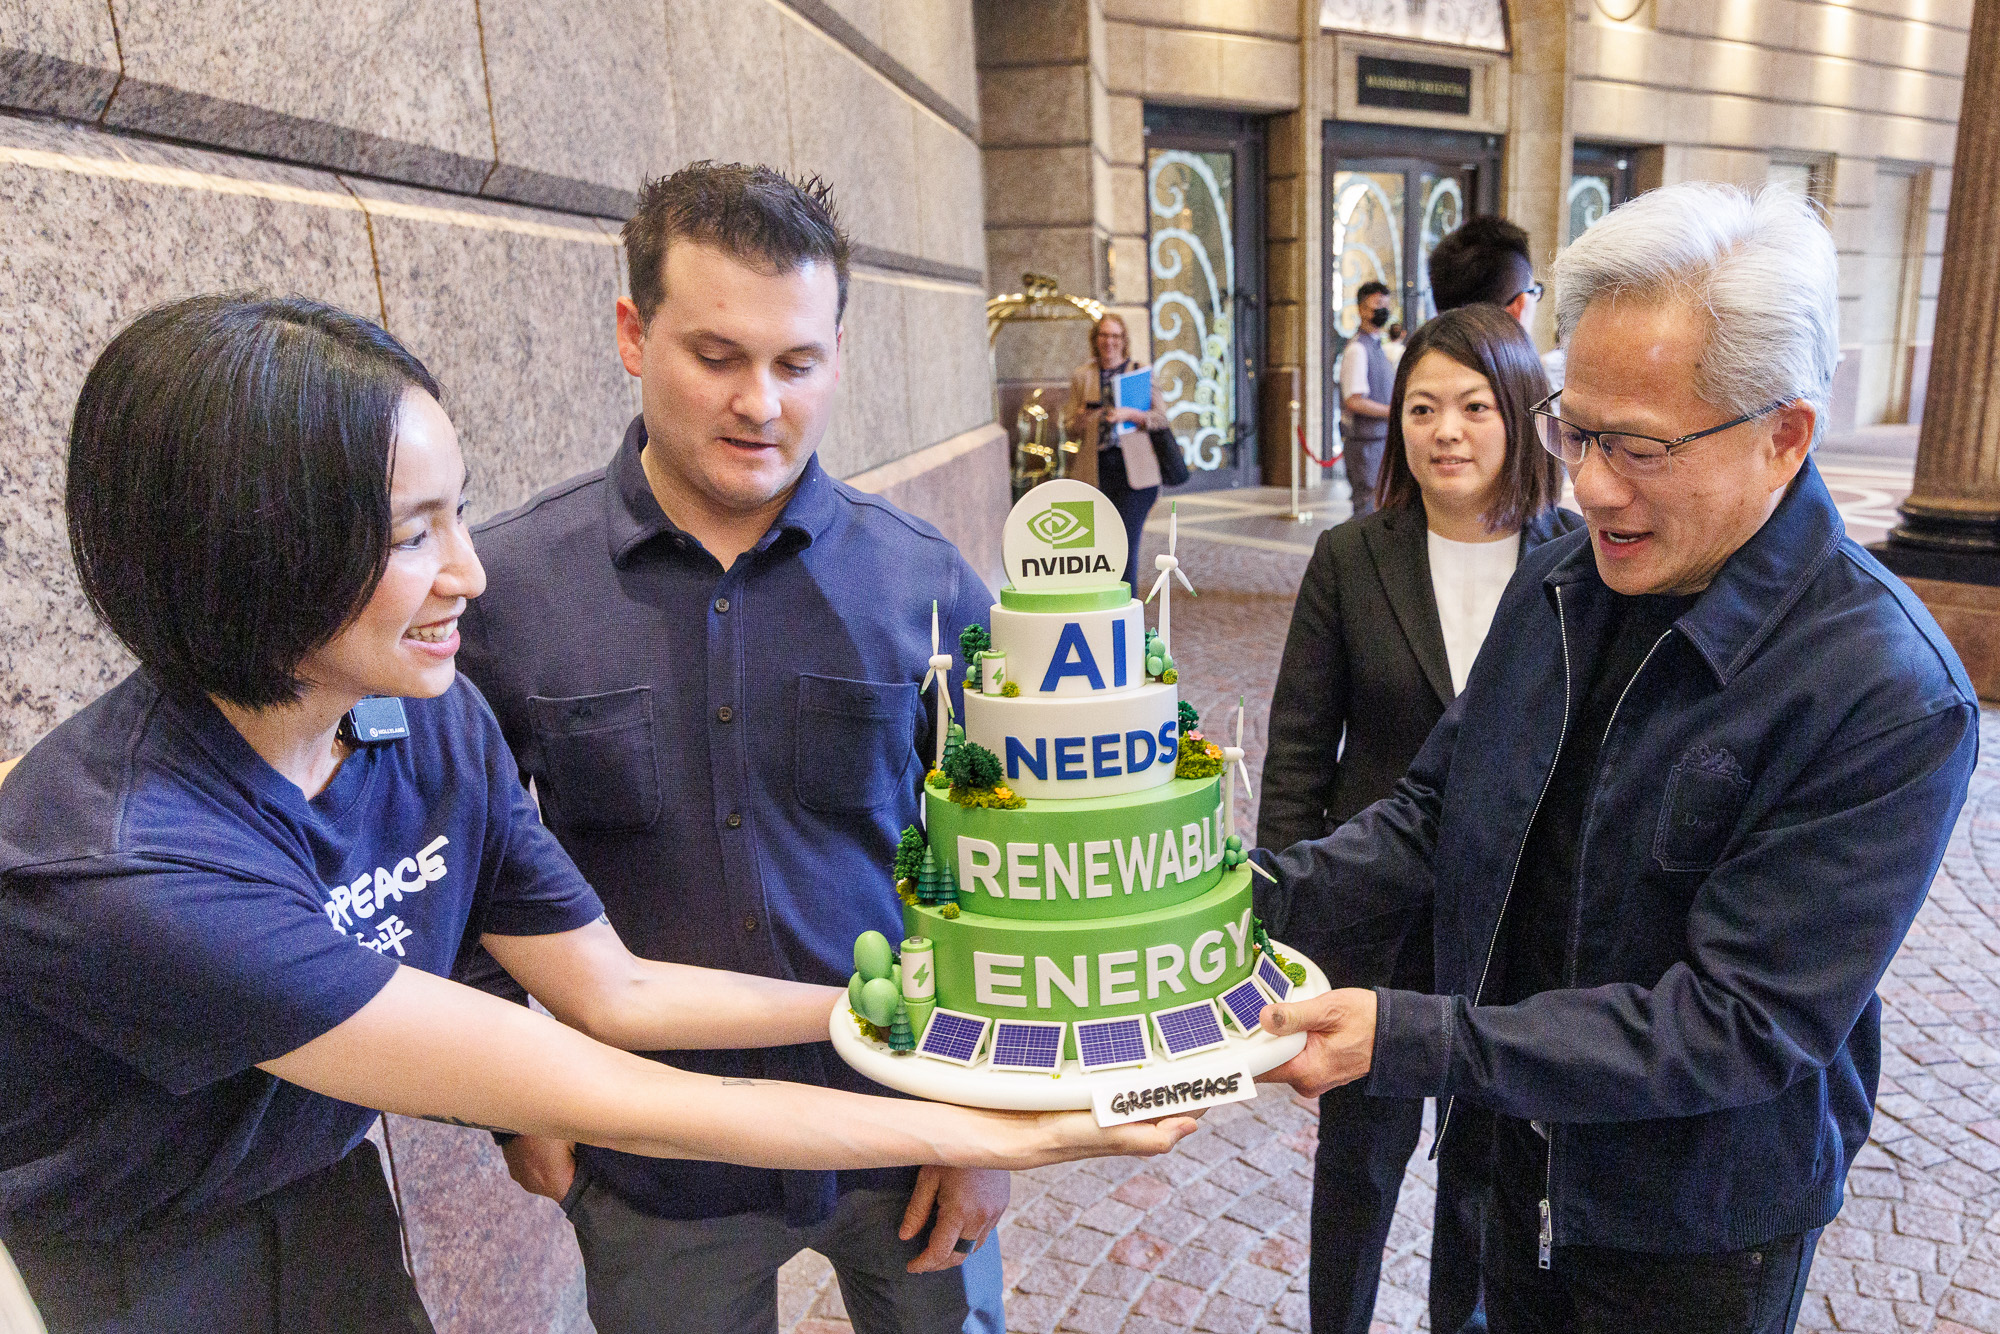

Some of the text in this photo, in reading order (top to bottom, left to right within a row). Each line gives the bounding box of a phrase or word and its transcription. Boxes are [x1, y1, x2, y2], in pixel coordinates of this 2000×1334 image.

[1039, 618, 1128, 692] AI
[1005, 720, 1178, 781] NEEDS
[973, 908, 1252, 1009] ENERGY
[1110, 1072, 1242, 1116] GREENPEACE
